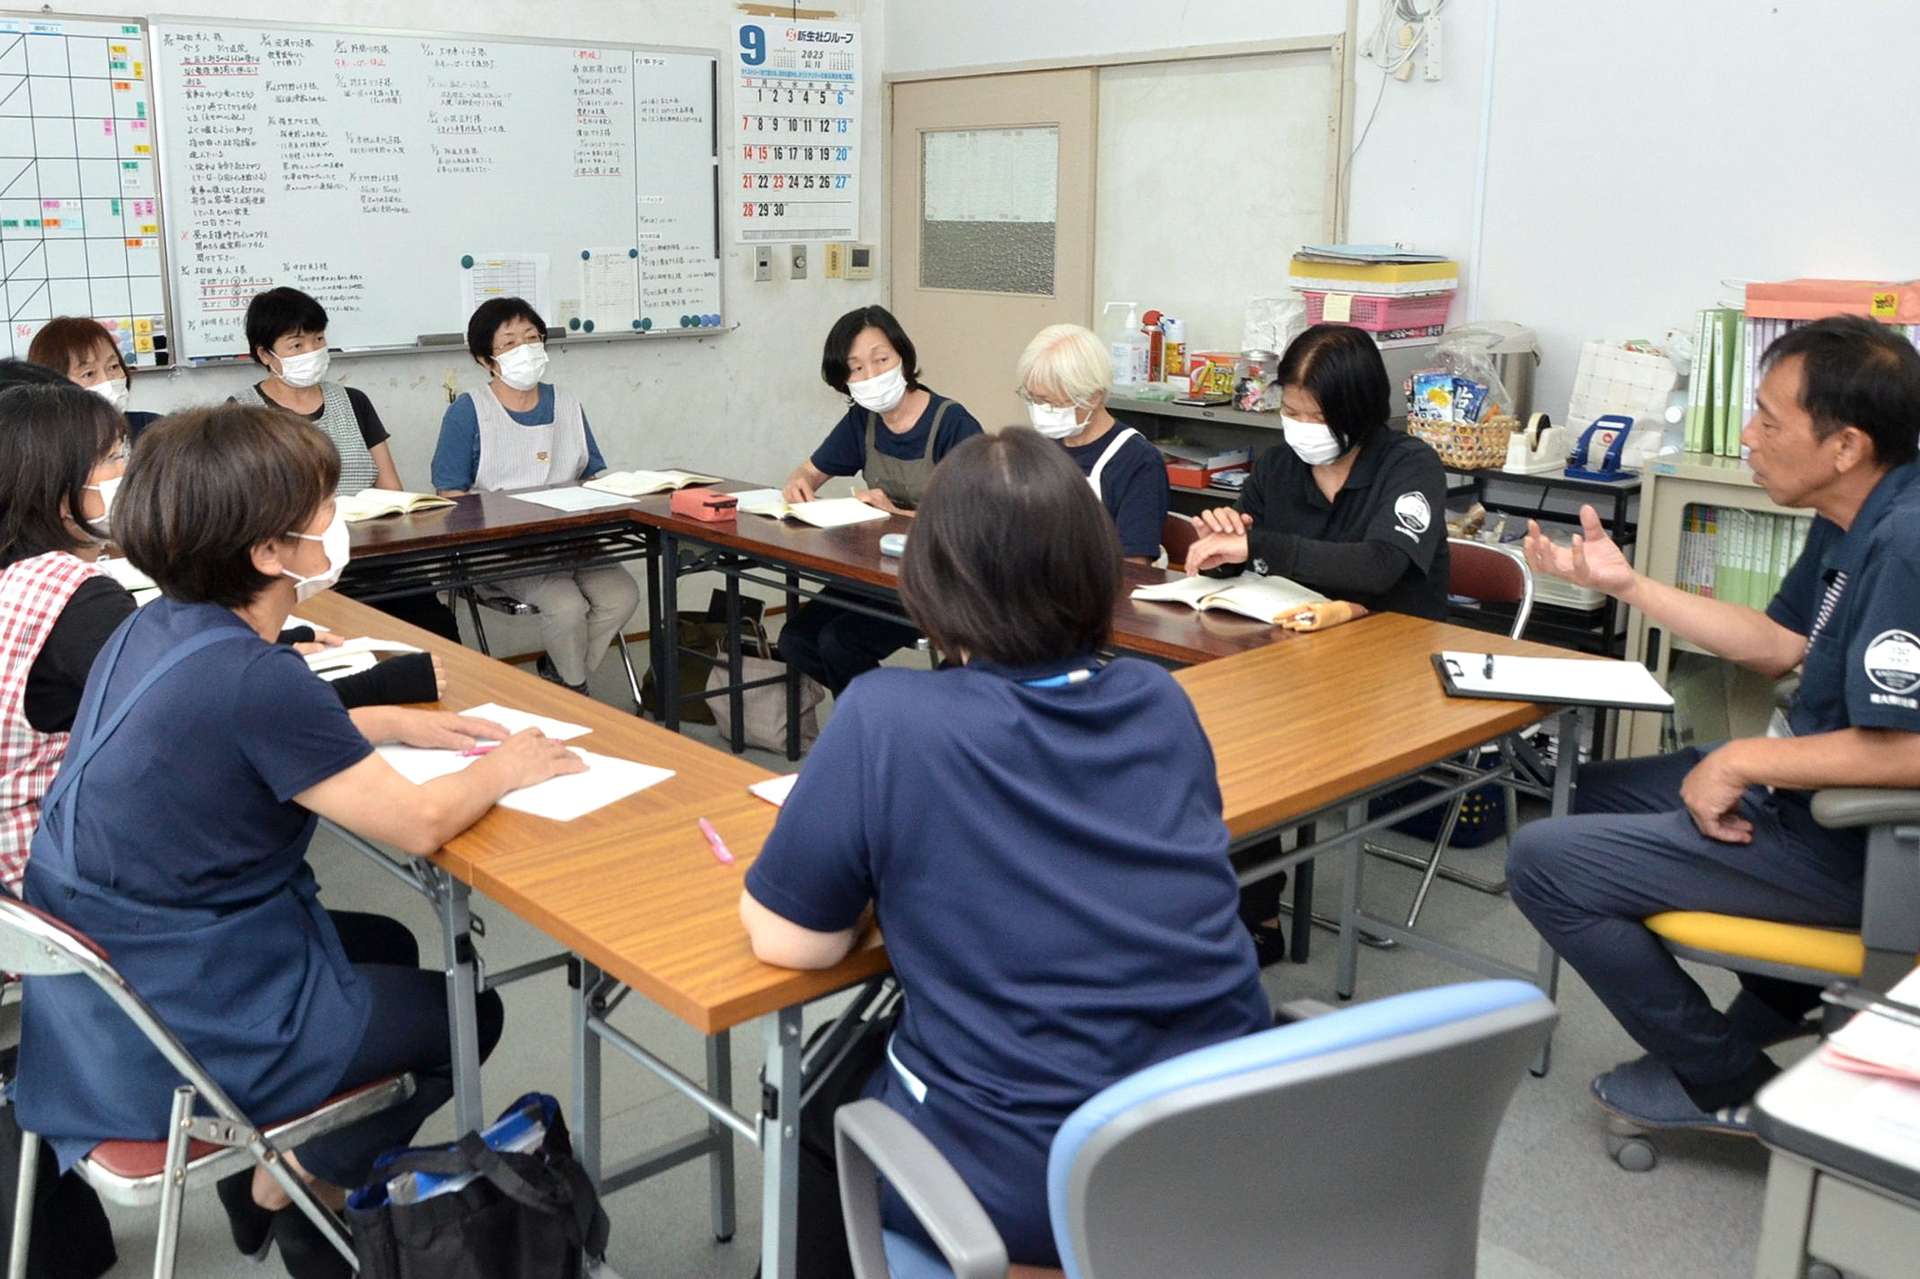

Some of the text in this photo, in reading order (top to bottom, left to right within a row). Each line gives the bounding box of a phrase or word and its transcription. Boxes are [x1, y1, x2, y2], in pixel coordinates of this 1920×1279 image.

[740, 25, 766, 66] 9
[801, 50, 824, 59] 2025
[758, 89, 843, 104] 1 2 3 4 5 6
[743, 117, 847, 133] 7 8 9 10 11 12 13
[744, 146, 847, 160] 14 15 16 17 18 19 20
[743, 175, 847, 188] 21 22 23 24 25 26 27
[743, 203, 784, 216] 28 29 30
